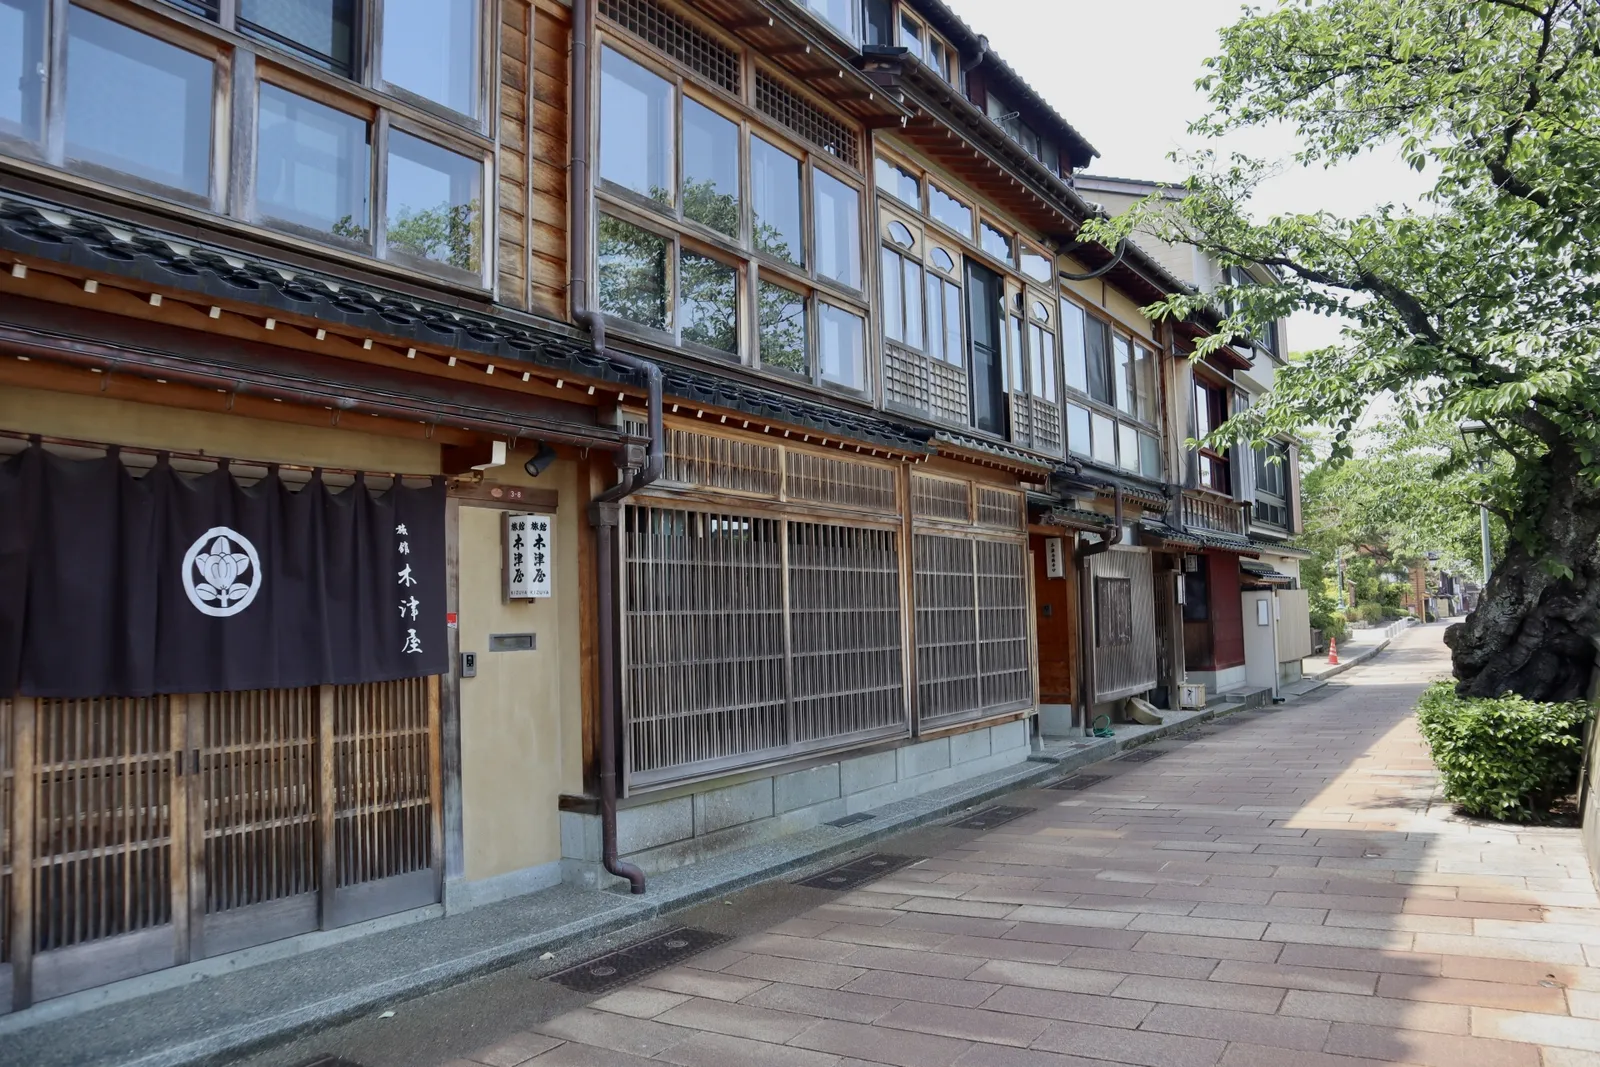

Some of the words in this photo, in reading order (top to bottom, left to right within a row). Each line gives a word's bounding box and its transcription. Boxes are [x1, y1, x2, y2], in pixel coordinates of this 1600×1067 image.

[510, 490, 522, 498] 3-8
[512, 533, 525, 584] 木津屋
[532, 533, 546, 584] 木津屋
[397, 563, 423, 654] 木津屋
